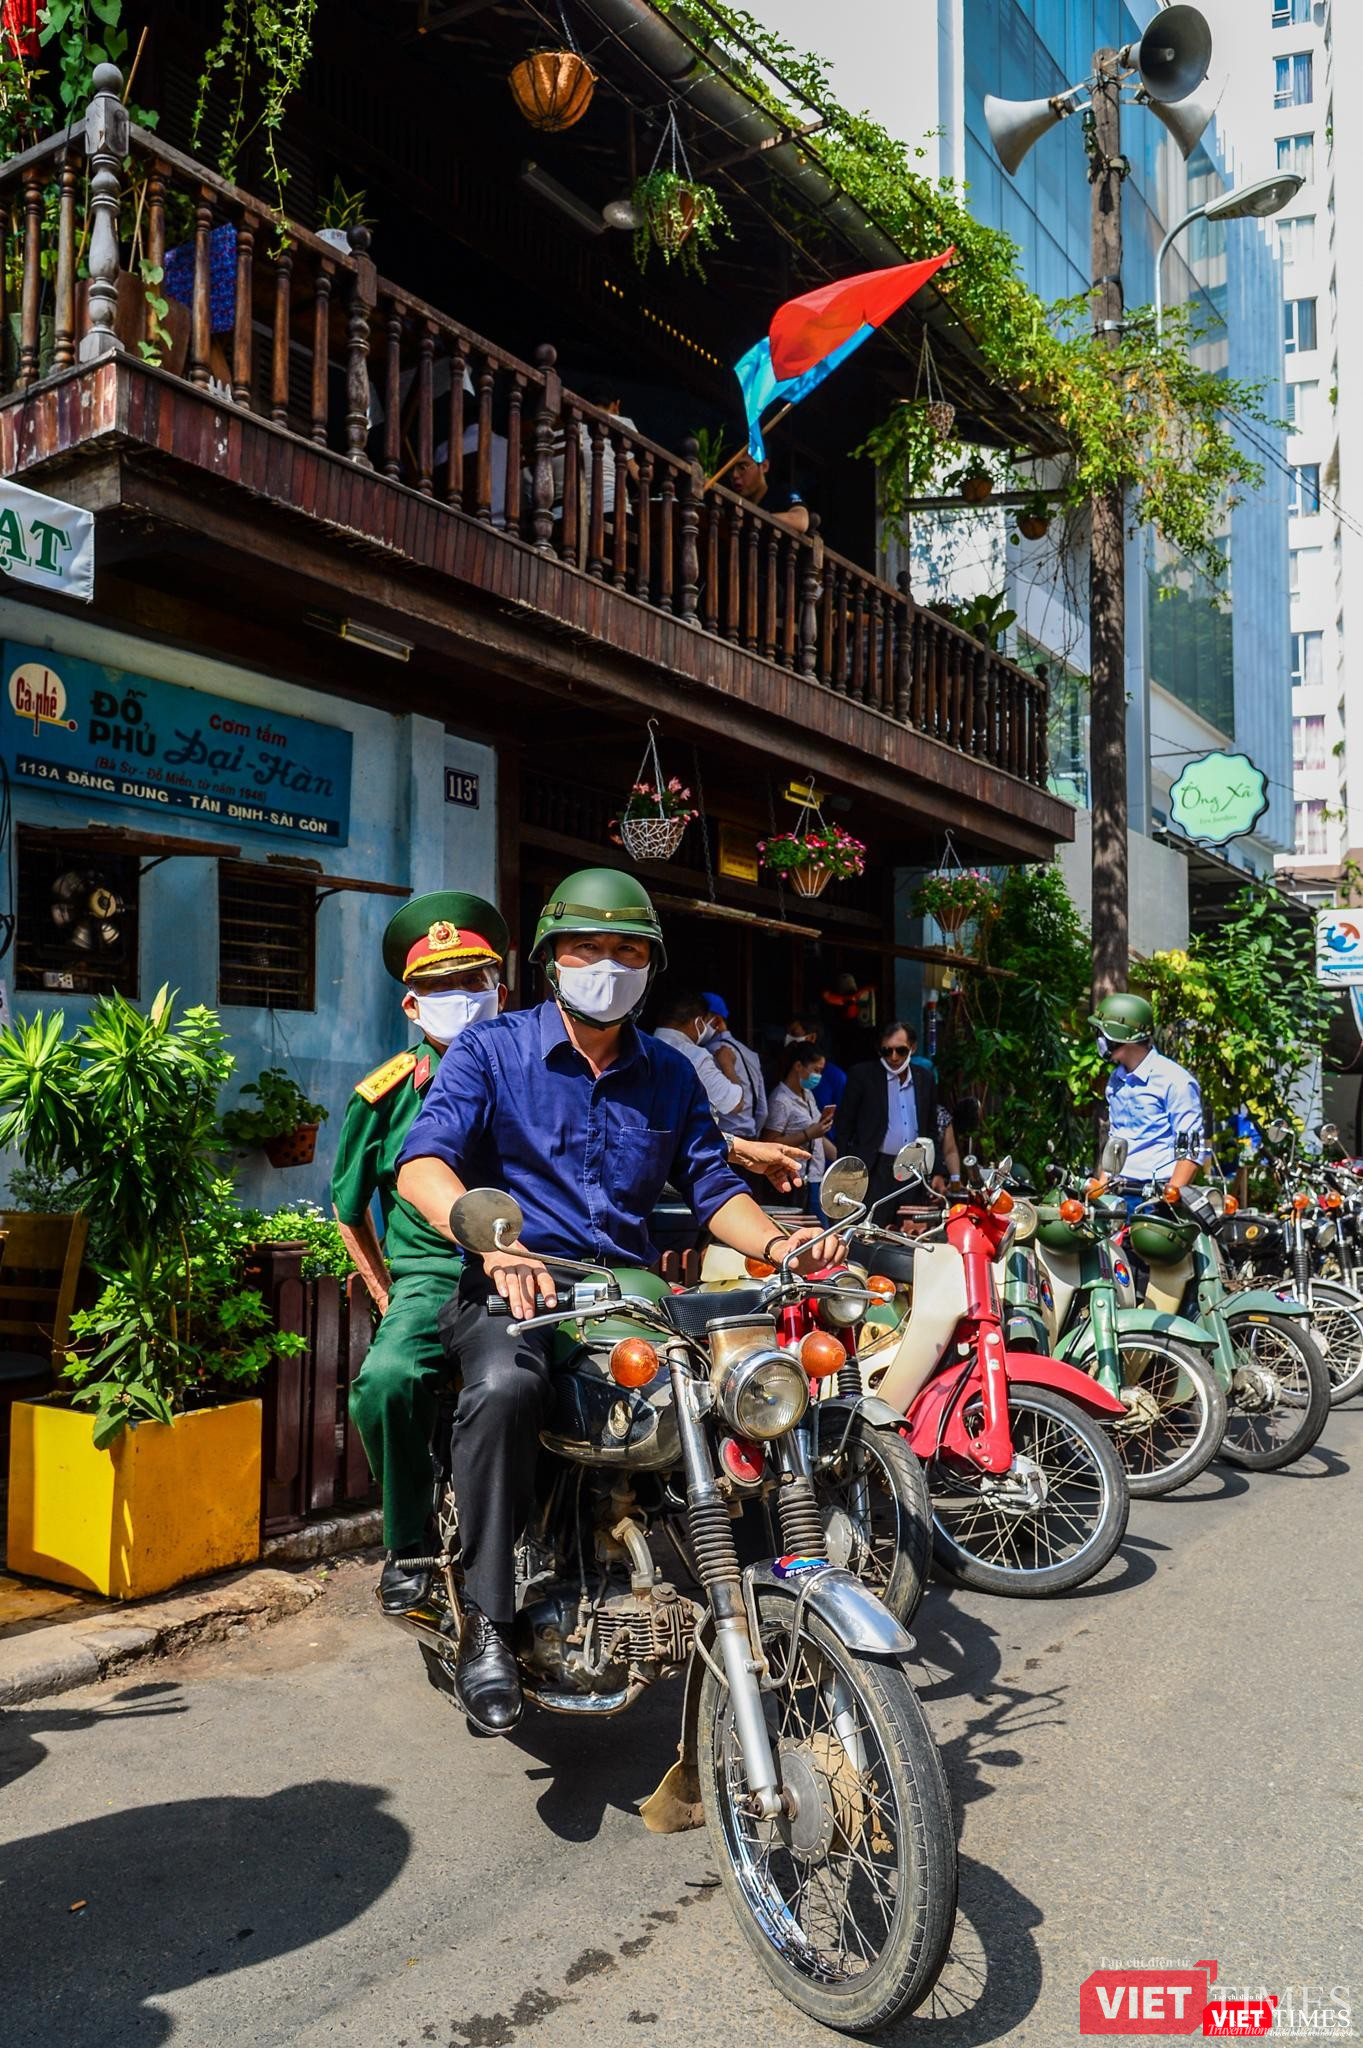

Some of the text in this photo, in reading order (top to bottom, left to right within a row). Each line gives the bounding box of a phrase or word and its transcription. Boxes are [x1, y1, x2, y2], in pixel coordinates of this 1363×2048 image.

[90, 688, 147, 725] ĐỖ
[89, 719, 156, 757] PHỦ
[209, 714, 287, 748] Cơm tấm
[19, 761, 60, 781] 113A
[65, 771, 116, 793] ĐẶNG
[122, 783, 169, 802] DUNG
[190, 795, 221, 813] TÂN
[298, 818, 328, 834] GÒN
